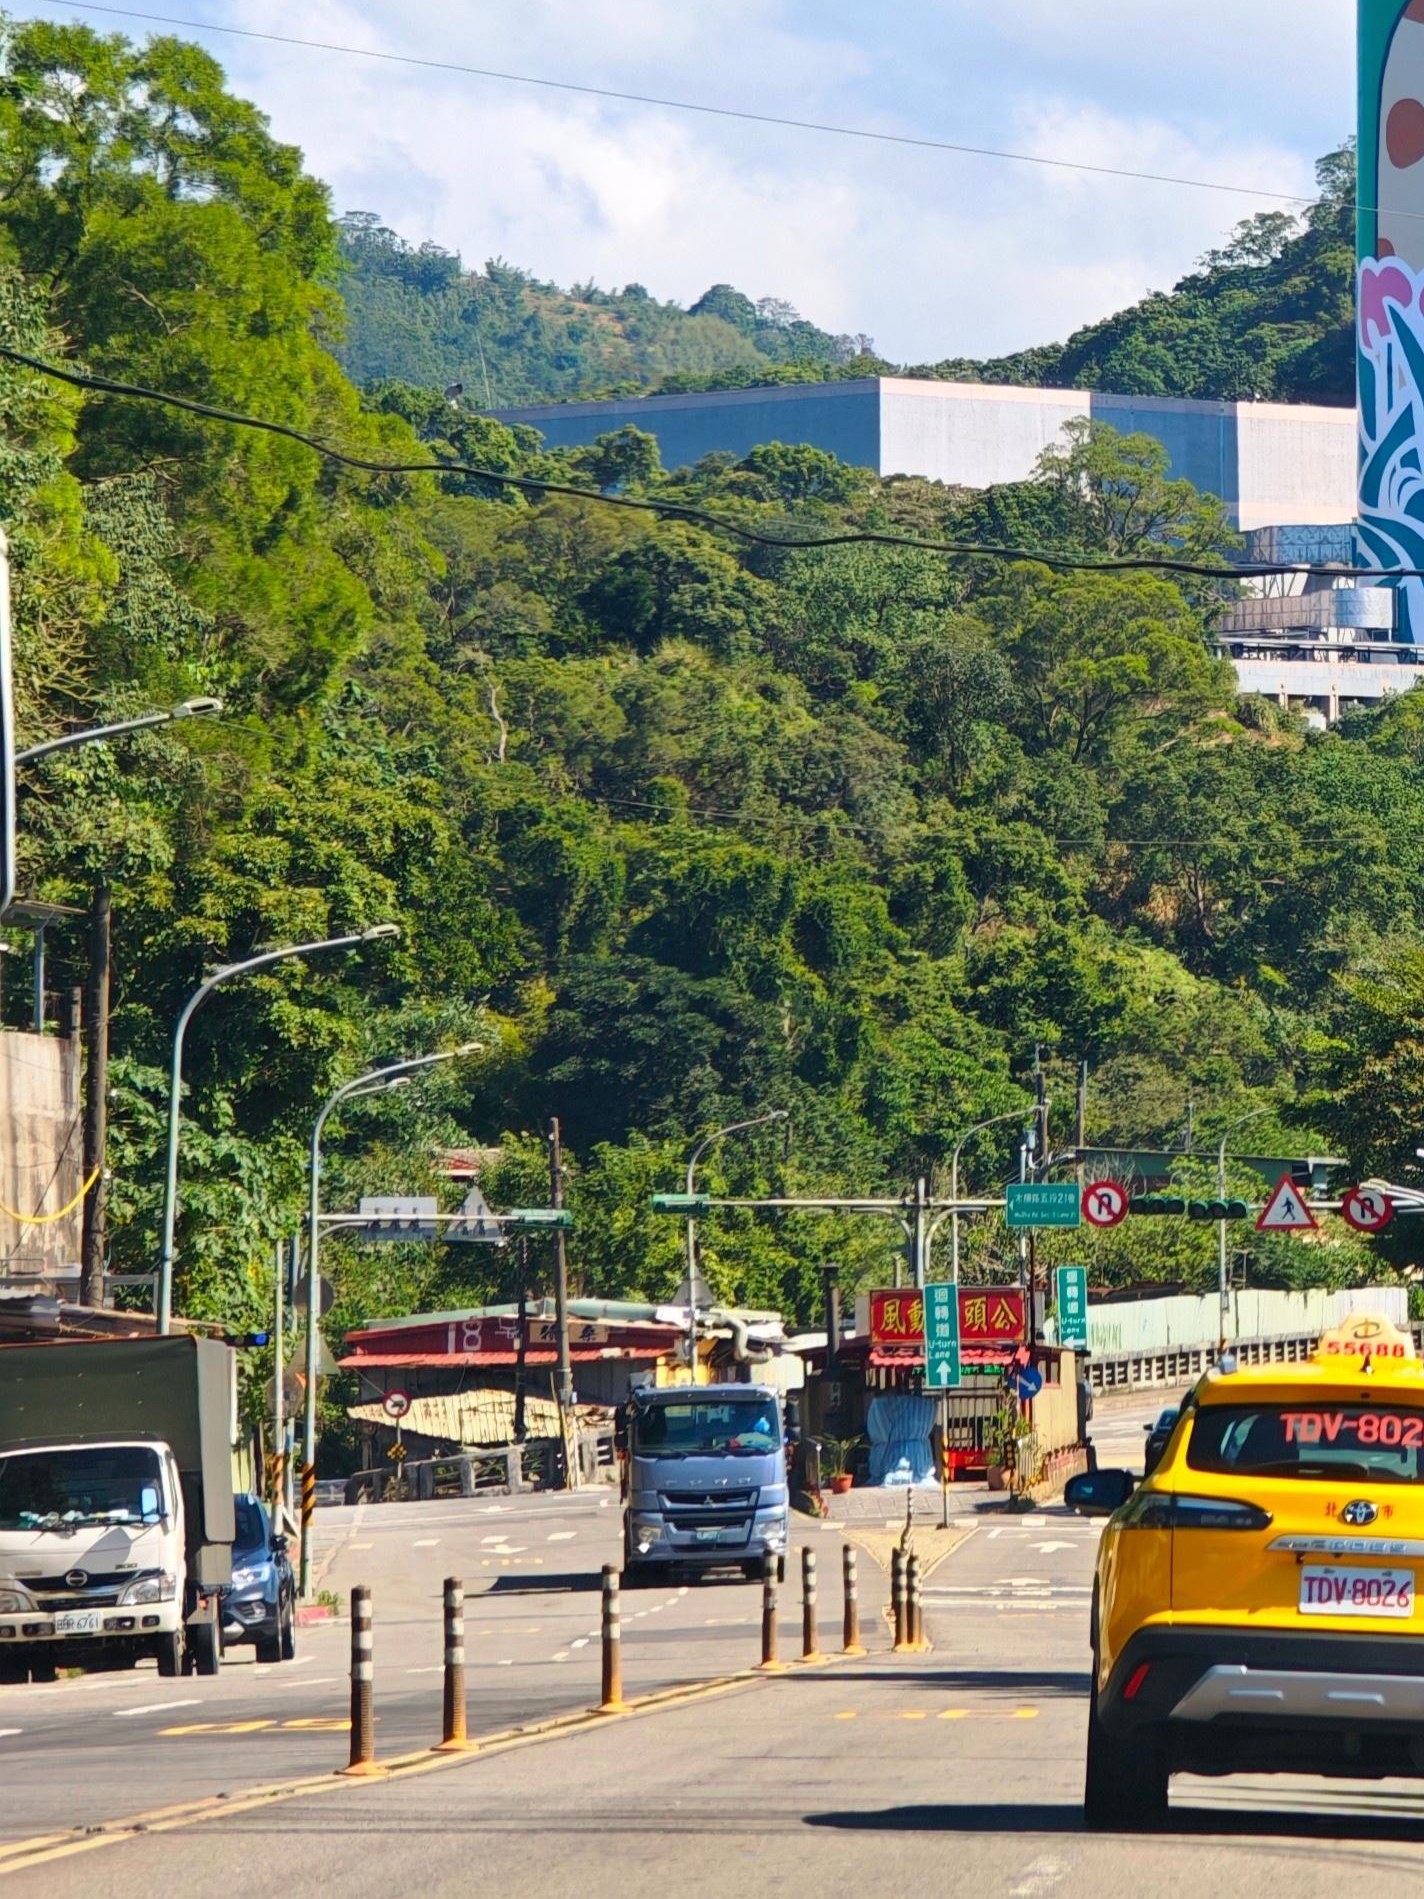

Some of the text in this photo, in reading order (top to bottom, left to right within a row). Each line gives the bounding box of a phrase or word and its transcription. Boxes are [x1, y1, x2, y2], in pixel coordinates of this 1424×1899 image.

[880, 1296, 1018, 1335] 風動頭公
[928, 1339, 957, 1349] U-turn
[1327, 1340, 1405, 1358] 55688
[928, 1351, 951, 1360] Lane
